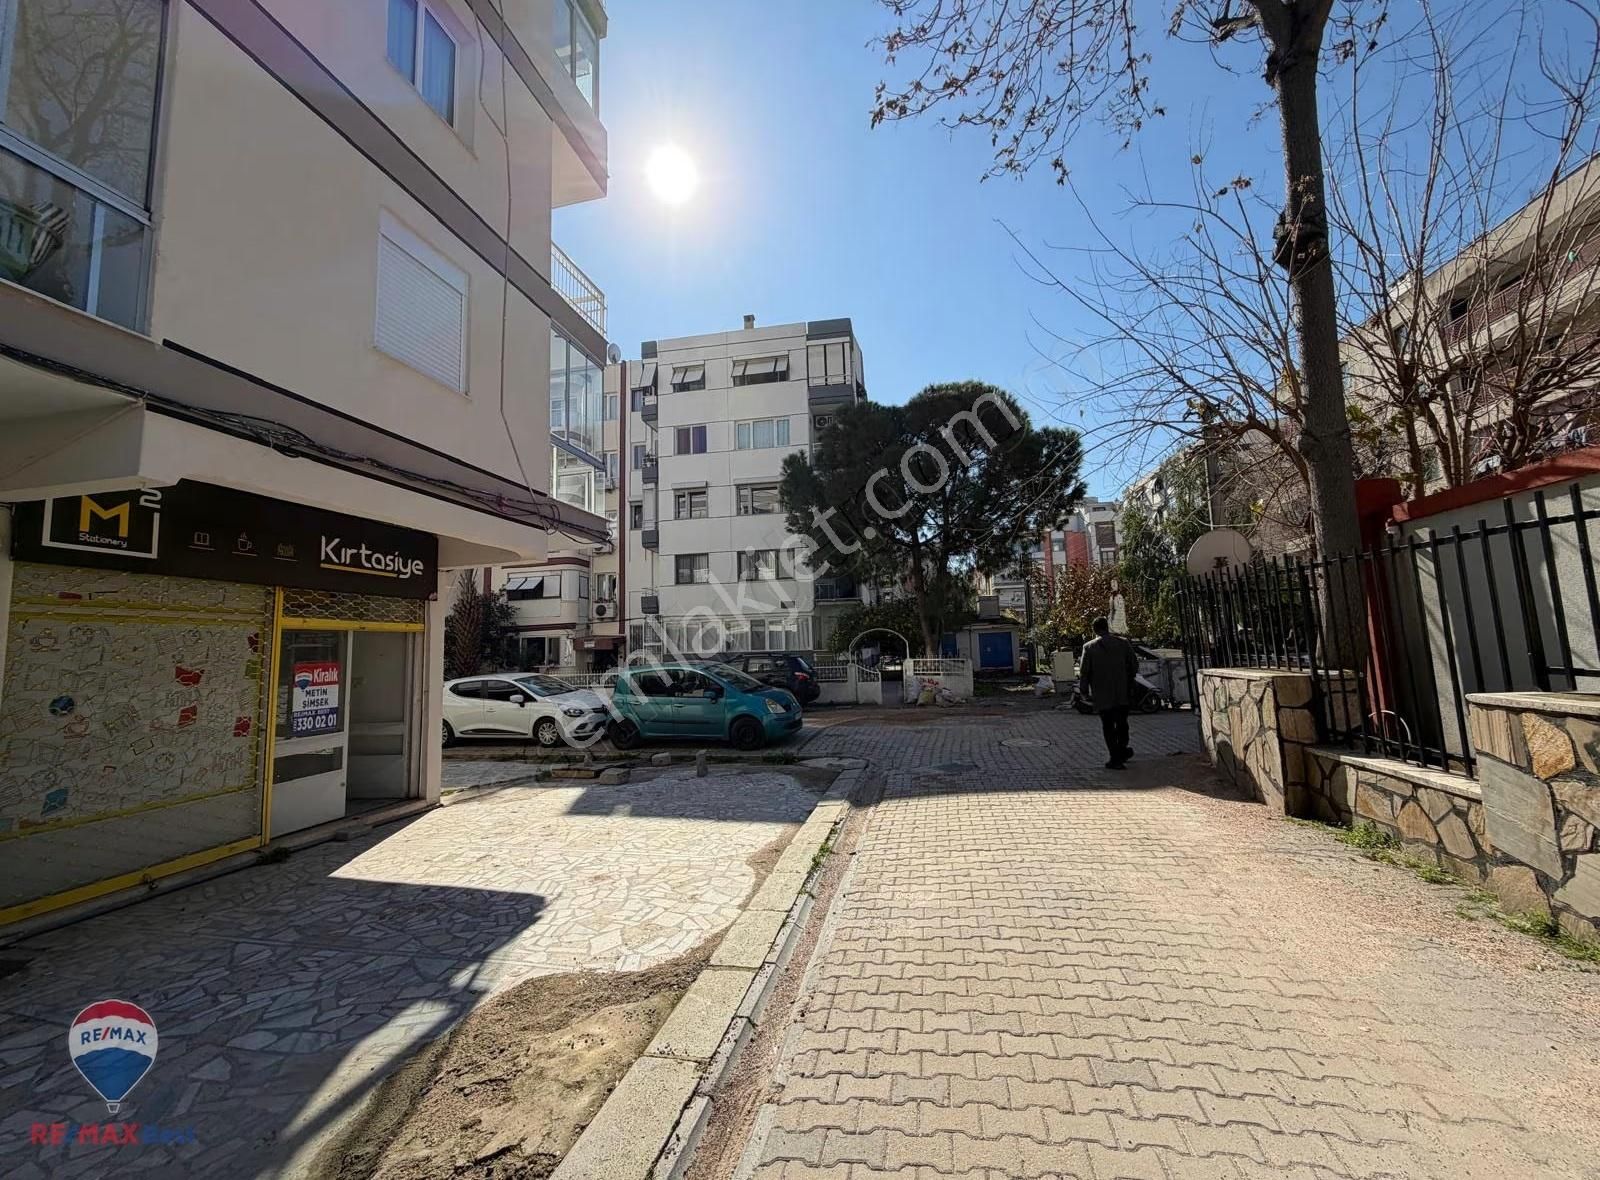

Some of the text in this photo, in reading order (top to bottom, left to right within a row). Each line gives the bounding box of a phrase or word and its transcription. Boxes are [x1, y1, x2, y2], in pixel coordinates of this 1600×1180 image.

[79, 532, 128, 548] Stationery
[320, 535, 424, 578] Kırtasiye
[313, 668, 338, 683] Kiralık
[305, 688, 328, 697] METİN
[297, 717, 313, 731] 330
[315, 715, 326, 728] 02
[328, 713, 337, 726] 01
